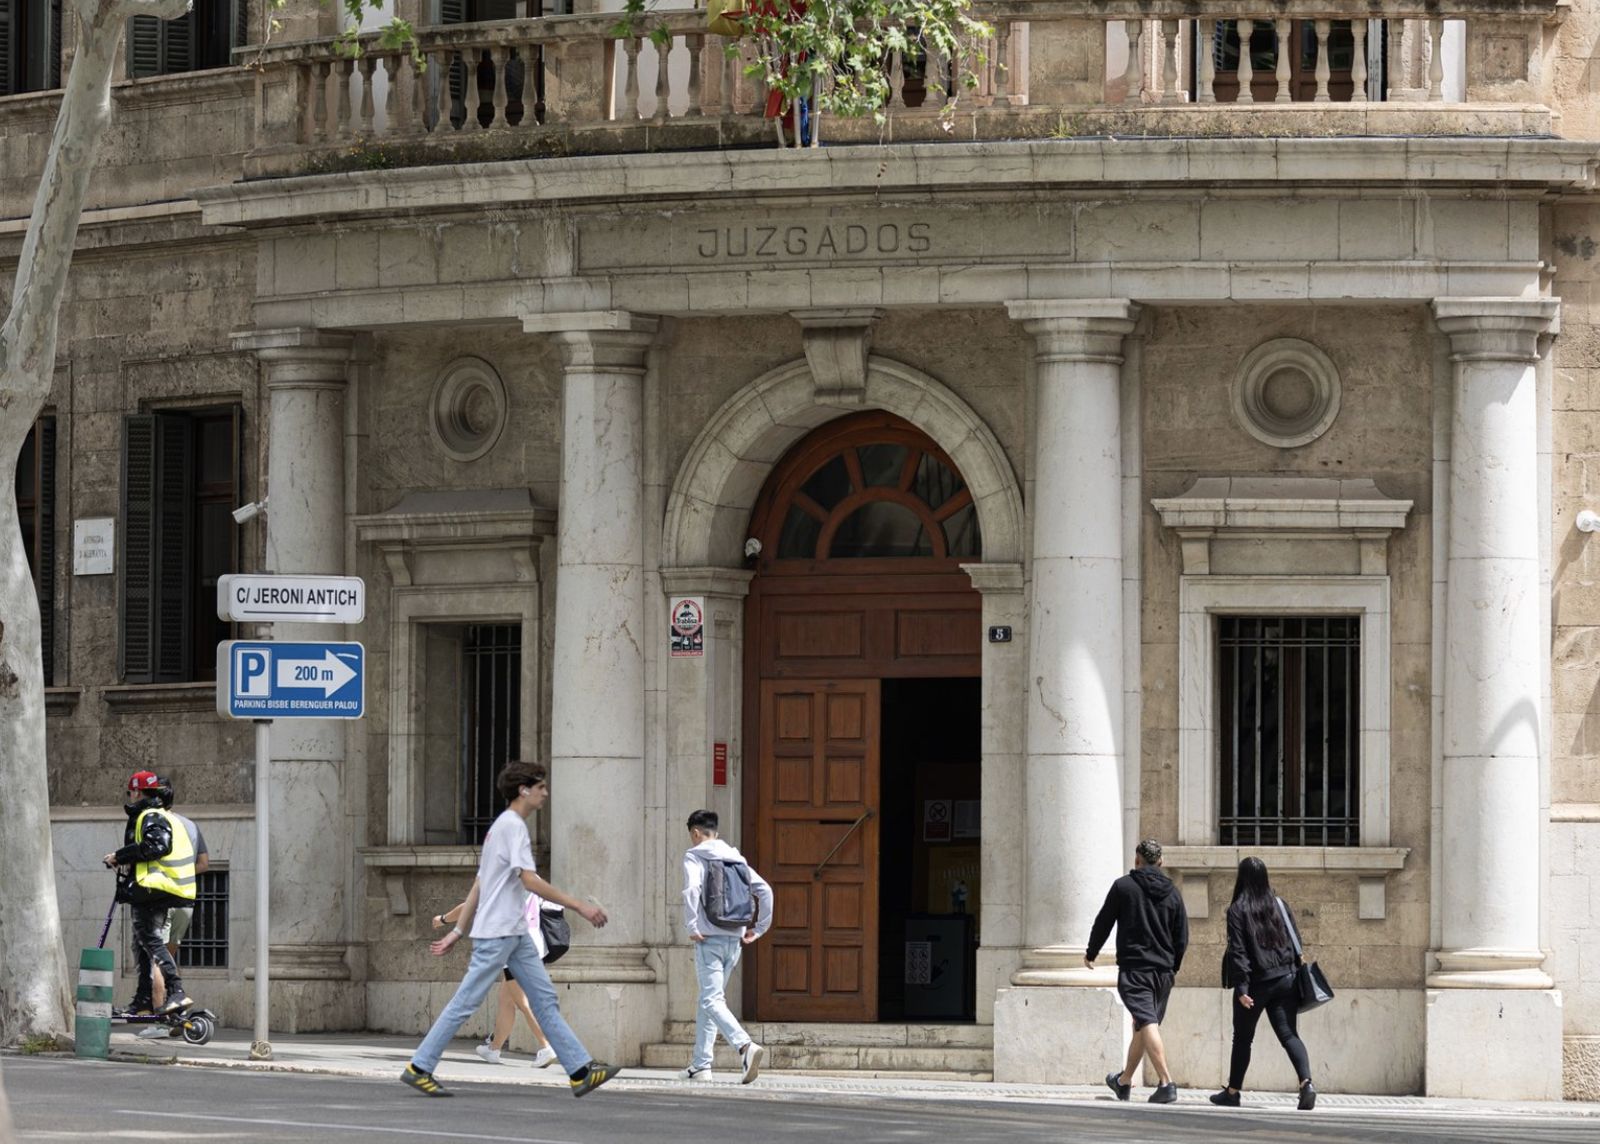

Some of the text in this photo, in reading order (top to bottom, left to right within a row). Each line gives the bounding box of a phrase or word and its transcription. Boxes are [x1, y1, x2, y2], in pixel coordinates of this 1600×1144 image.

[697, 222, 931, 258] JUZGADOS
[236, 587, 357, 606] C/ JERONI ANTICH
[996, 628, 1004, 640] 5
[241, 652, 266, 693] P
[294, 665, 333, 681] 200 m
[234, 699, 358, 710] PARKING BISBE BERENGUER PALOU
